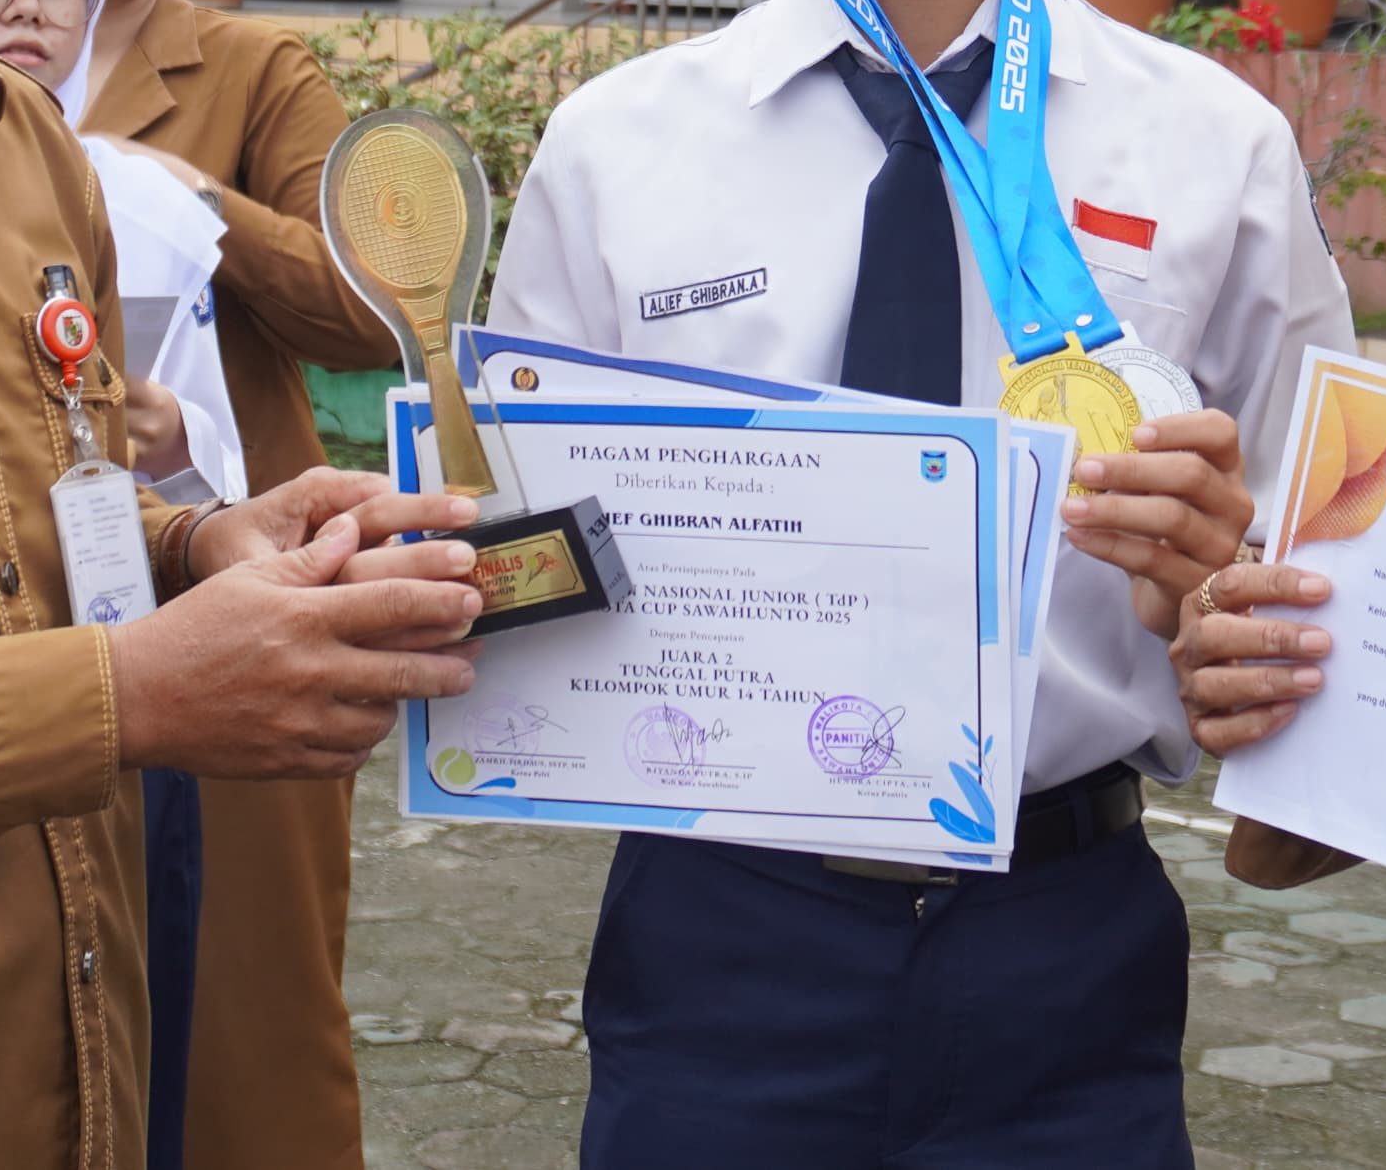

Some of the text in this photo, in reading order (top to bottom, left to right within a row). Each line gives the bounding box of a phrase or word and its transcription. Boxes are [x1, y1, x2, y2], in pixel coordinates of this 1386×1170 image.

[1000, 14, 1030, 113] 2025
[649, 276, 758, 314] ALIEF GHIBRAN.A
[569, 446, 821, 468] PIAGAM PENGHARGAAN
[614, 473, 697, 490] Diberikan
[704, 476, 763, 495] Kepada
[639, 513, 722, 530] GHIBRAN
[728, 517, 803, 533] ALFATIH
[472, 556, 524, 579] FINALIS
[662, 564, 729, 577] Partisipasinya
[733, 567, 756, 577] Pada
[644, 586, 735, 602] NASIONAL
[740, 589, 808, 605] JUNIOR
[826, 593, 858, 607] TdP
[641, 602, 677, 616] CUP
[682, 604, 809, 623] SAWAHLUNTO
[816, 611, 851, 624] 2025
[649, 629, 745, 643] Dengan Pencapaian
[659, 649, 733, 665] JUARA 2
[619, 663, 775, 684] TUNGGAL PUTRA
[570, 677, 826, 705] KELOMPOK UMUR 14 TAHUN
[1356, 692, 1377, 706] yang
